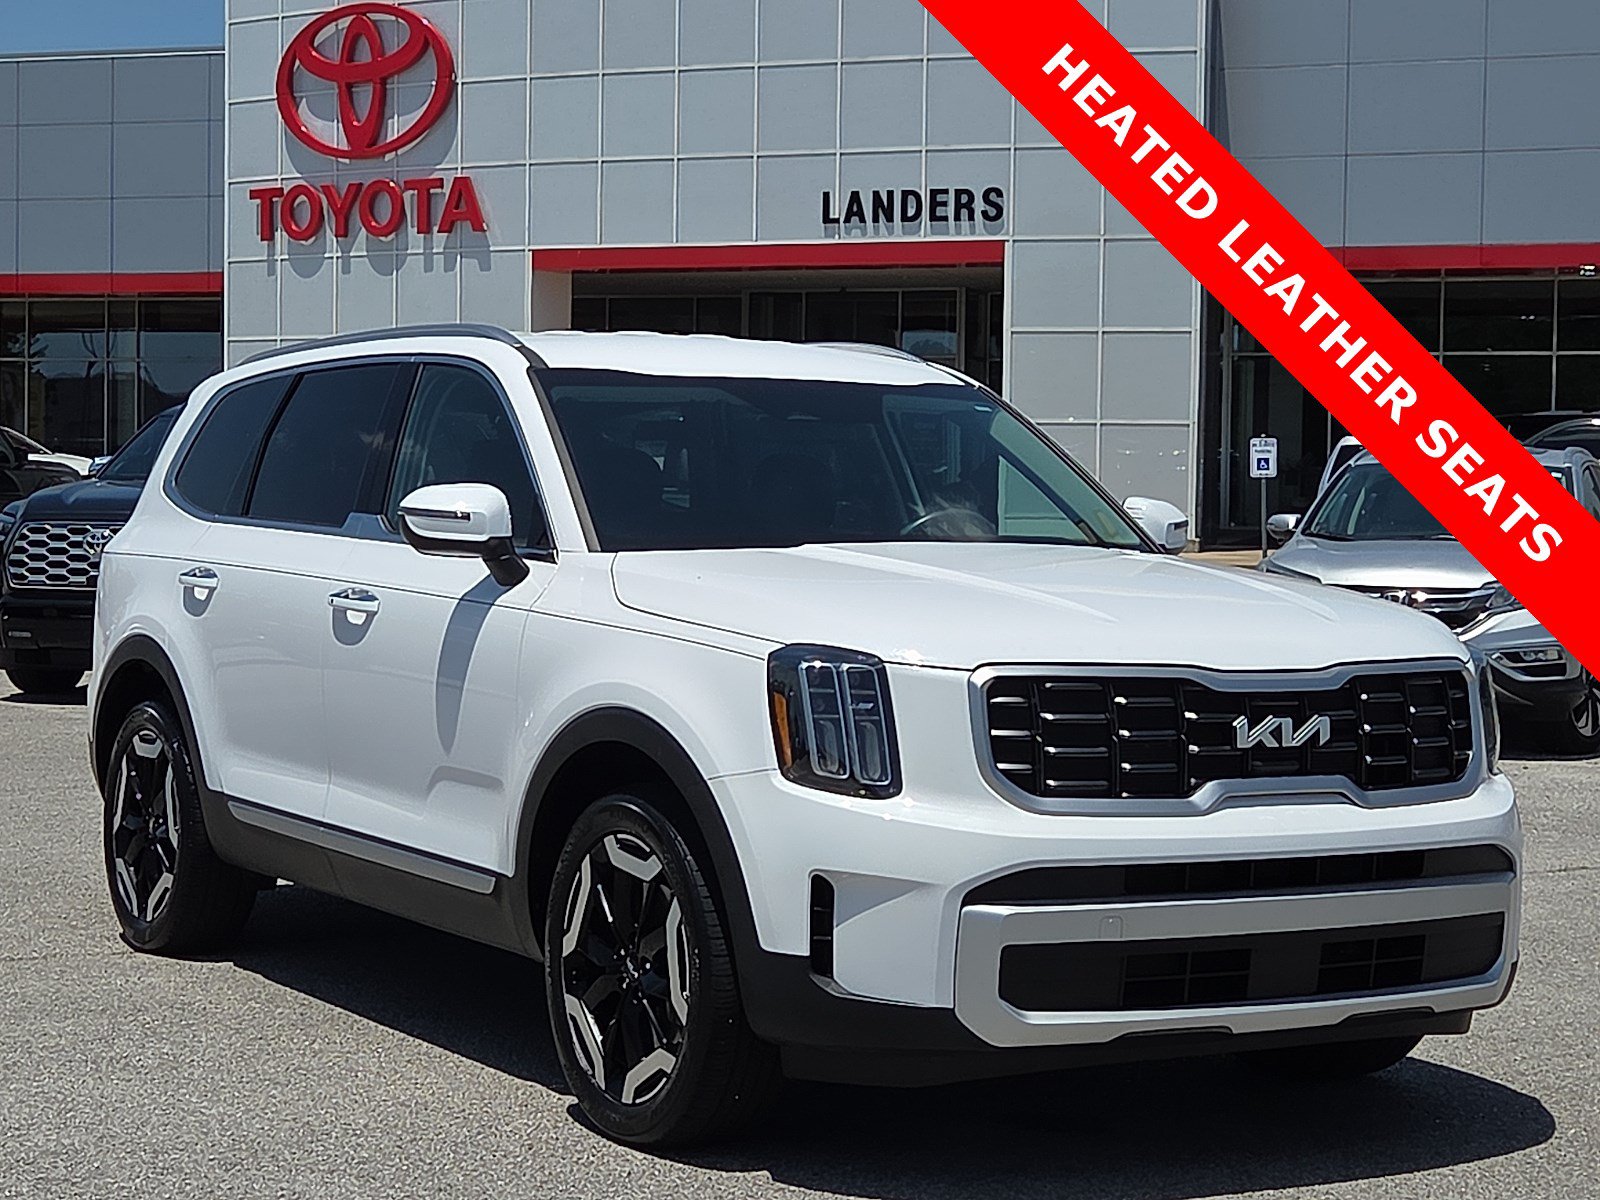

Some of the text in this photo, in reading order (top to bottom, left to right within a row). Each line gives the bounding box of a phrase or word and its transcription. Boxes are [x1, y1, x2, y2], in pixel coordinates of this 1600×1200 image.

[250, 176, 487, 241] TOYOTA
[822, 187, 1004, 225] LANDERS
[1232, 714, 1331, 748] KIA
